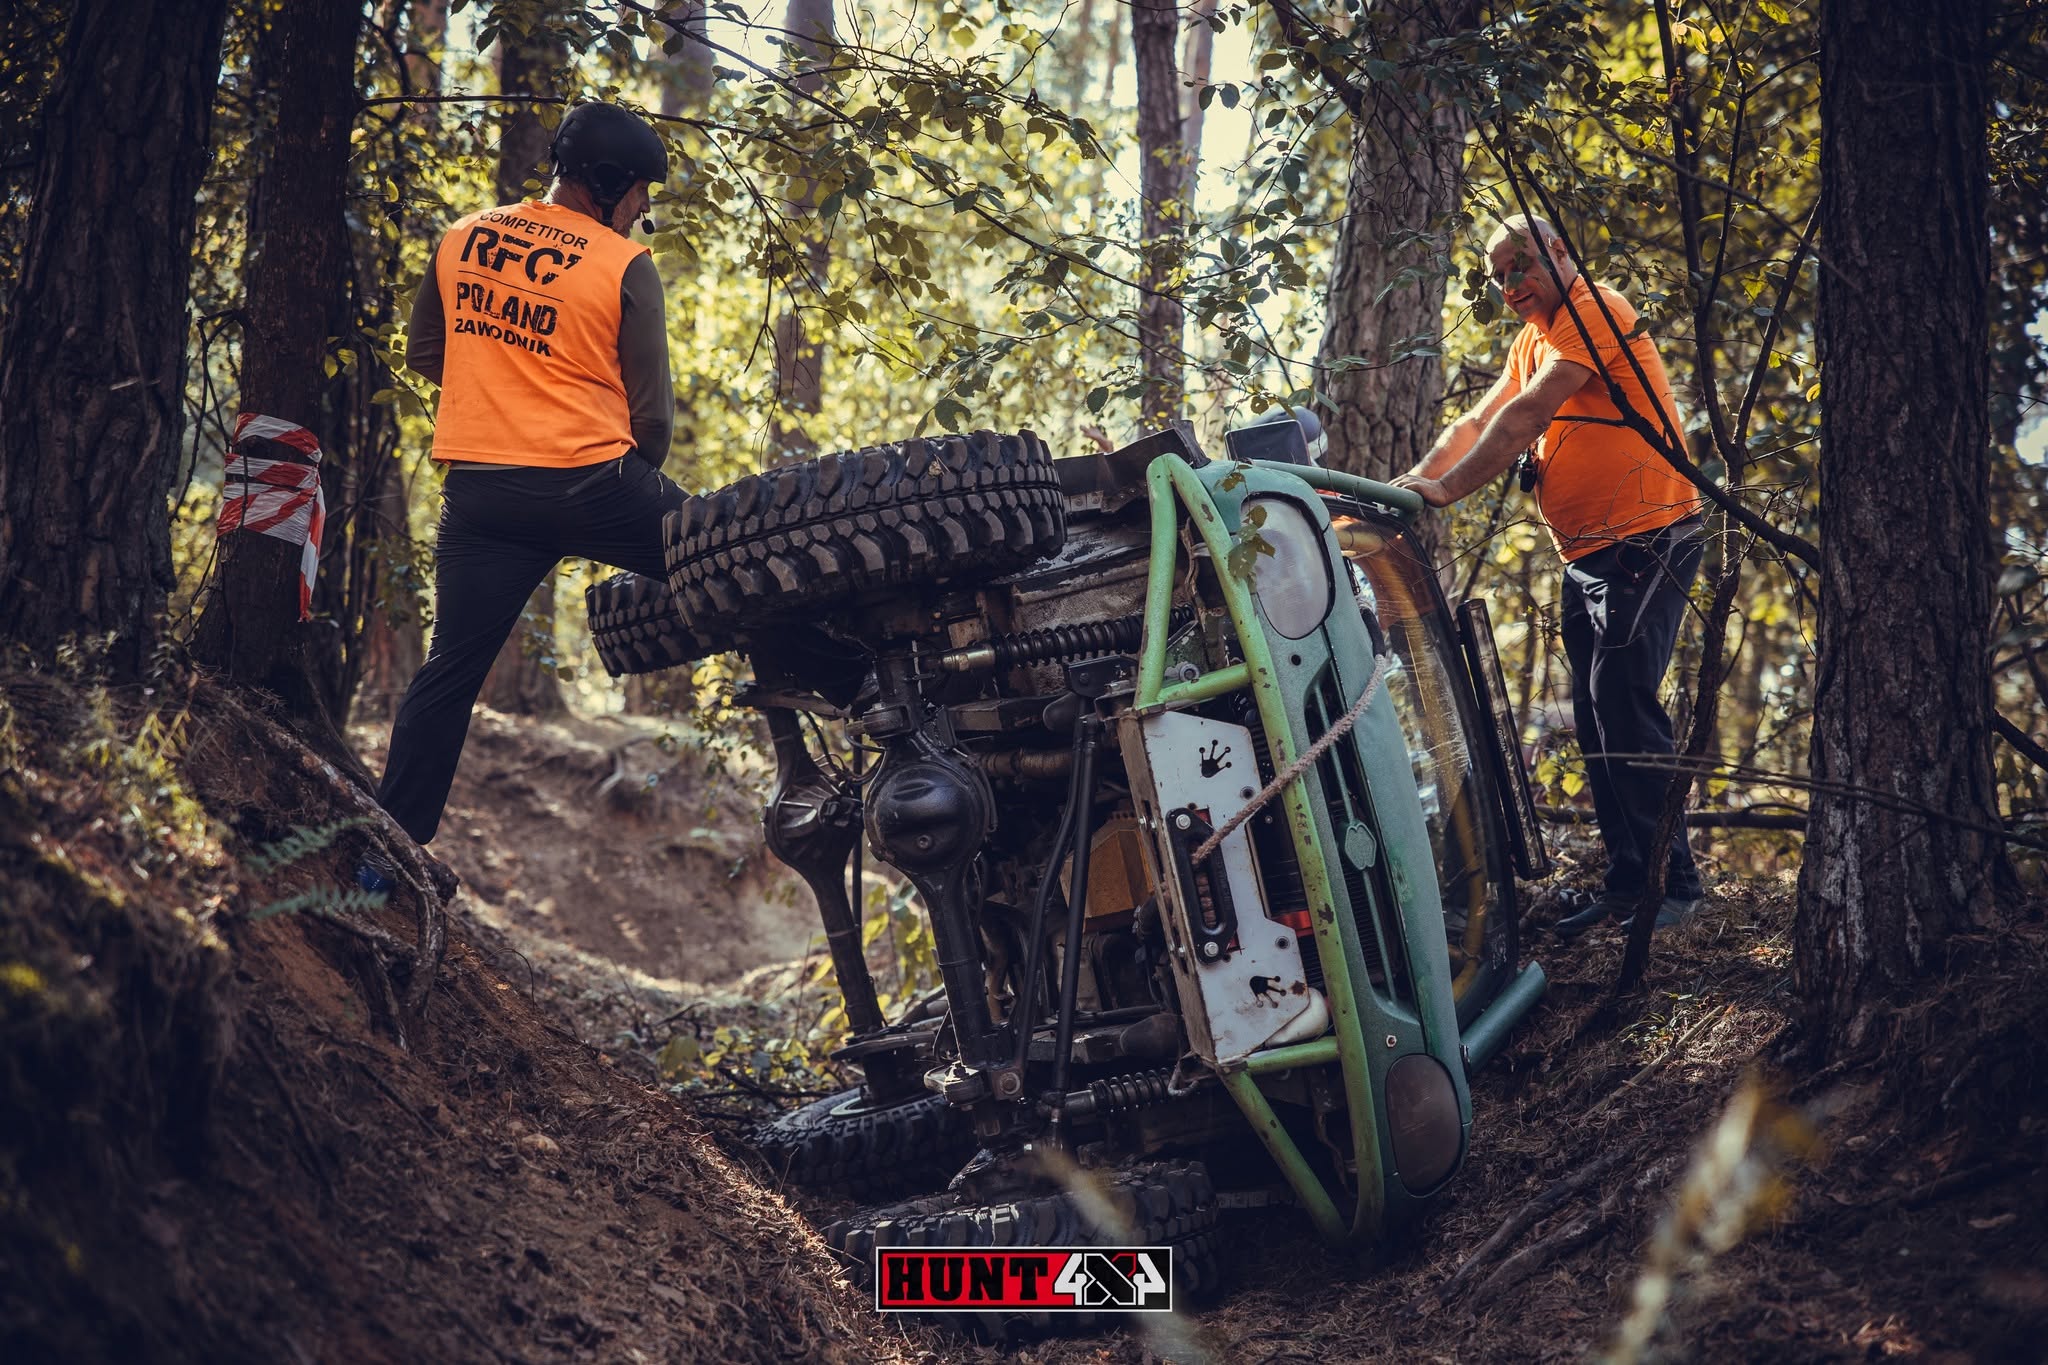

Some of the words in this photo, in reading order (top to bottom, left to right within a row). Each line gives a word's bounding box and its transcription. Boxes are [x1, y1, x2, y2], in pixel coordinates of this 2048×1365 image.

[480, 211, 589, 250] COMPETITOR
[456, 282, 558, 336] POLAND
[454, 318, 552, 357] ZAWODNIK
